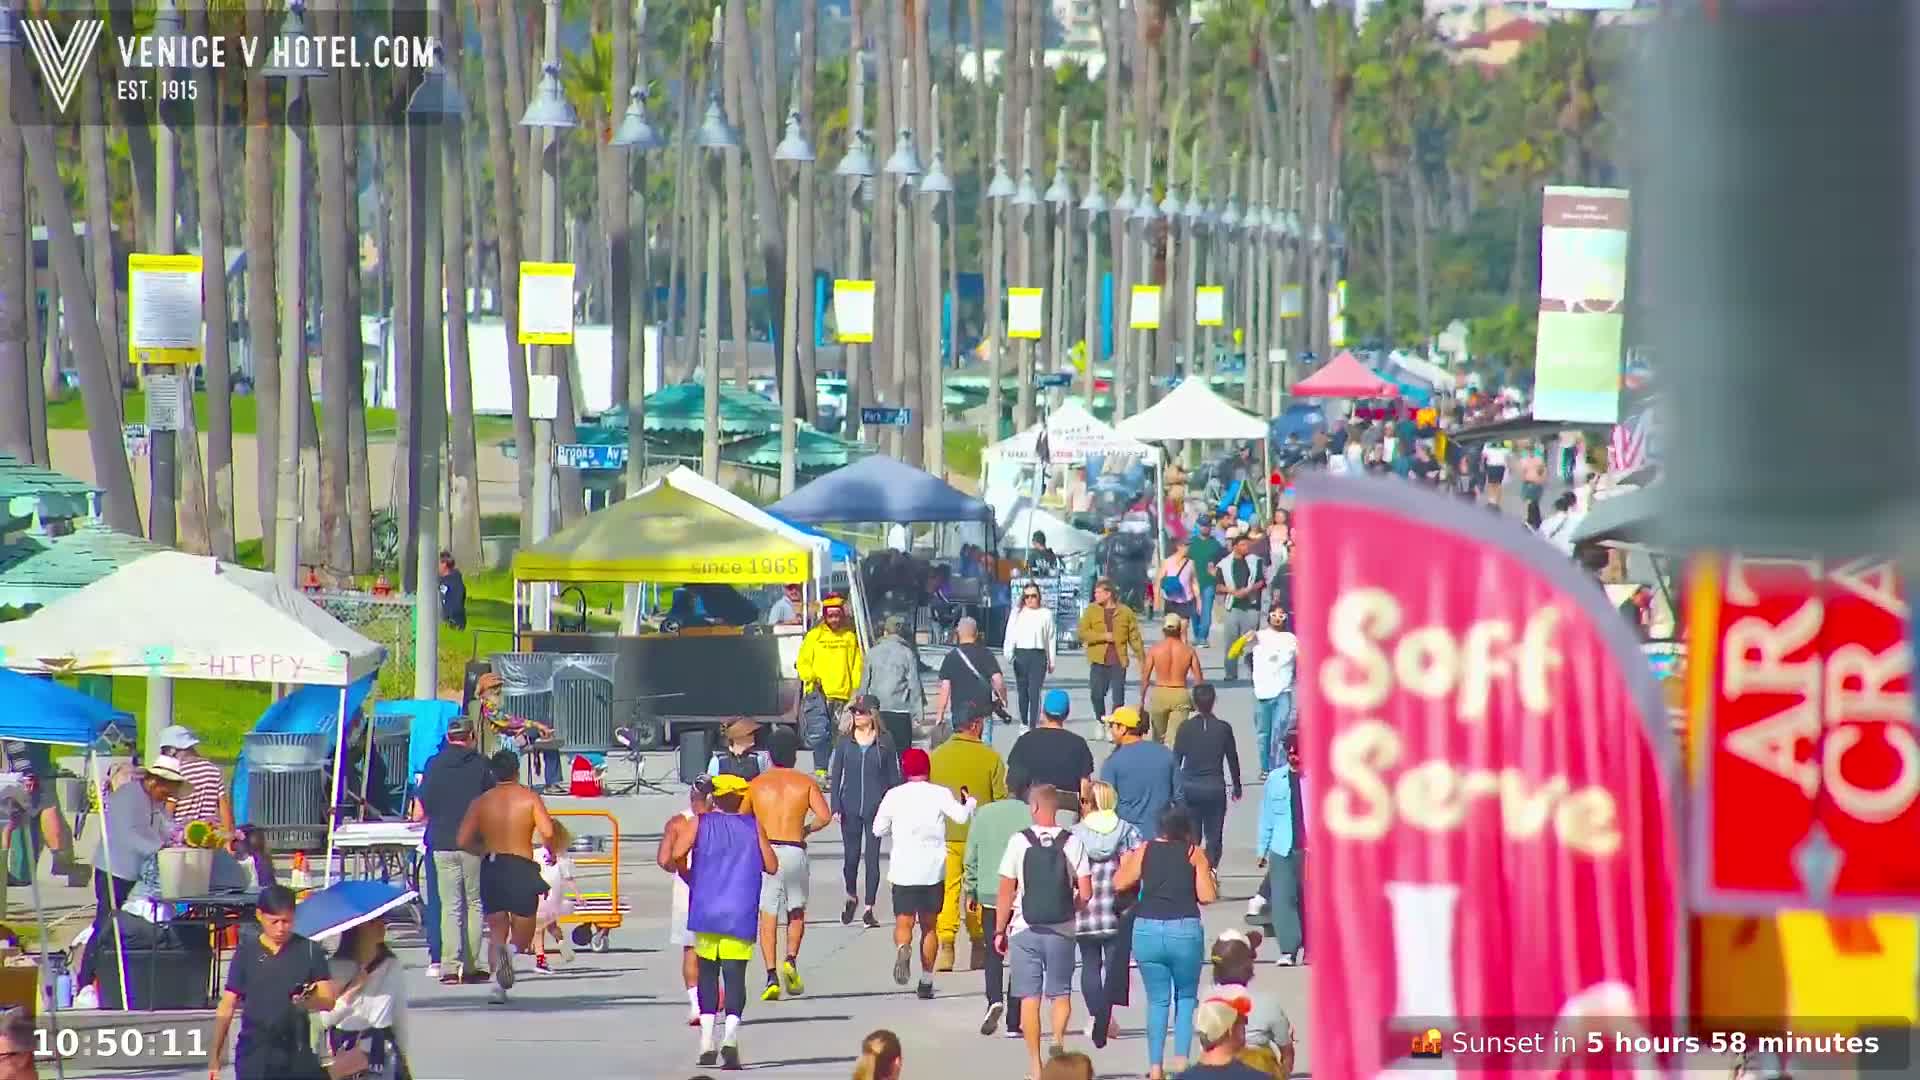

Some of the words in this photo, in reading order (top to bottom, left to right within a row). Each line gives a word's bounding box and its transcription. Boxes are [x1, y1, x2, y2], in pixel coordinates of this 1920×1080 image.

[558, 446, 595, 459] Brooks
[690, 560, 743, 575] since
[750, 557, 799, 575] 1965
[208, 654, 305, 679] HIPPY
[1318, 586, 1564, 722] Soft
[1322, 718, 1623, 858] Serve
